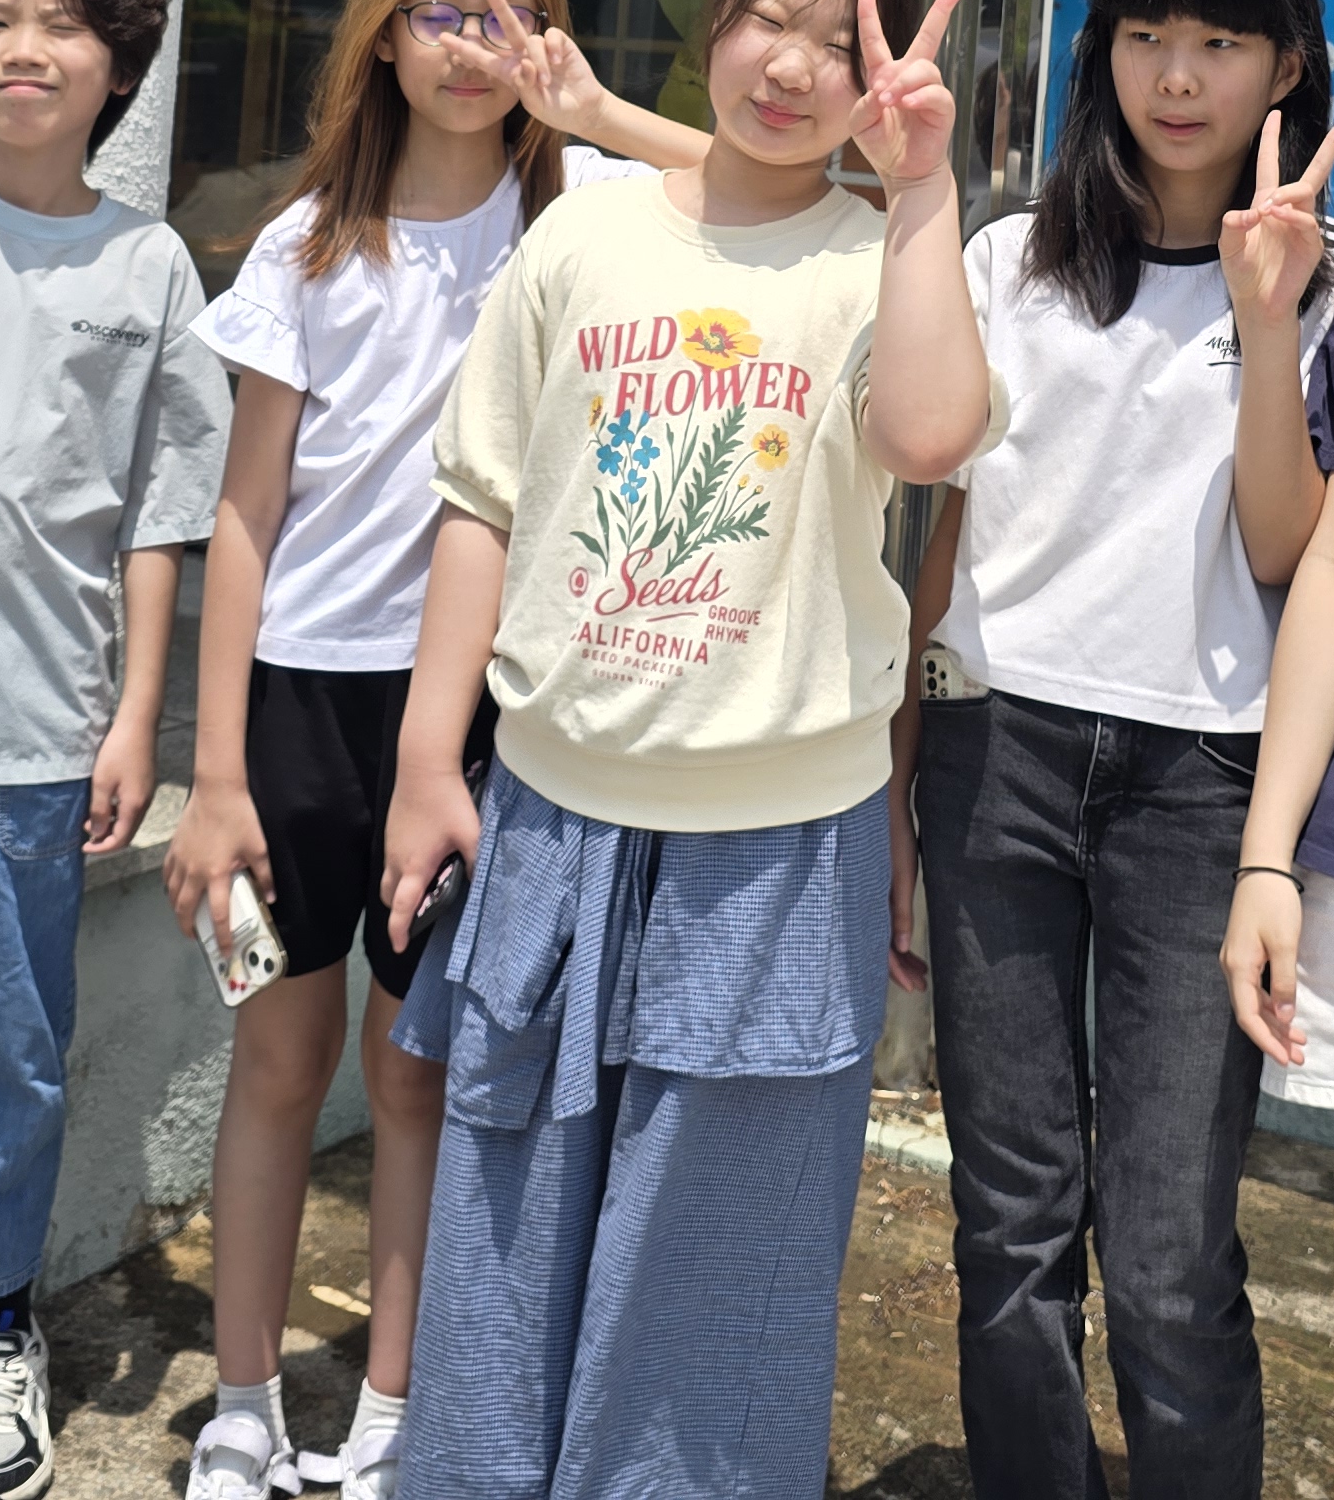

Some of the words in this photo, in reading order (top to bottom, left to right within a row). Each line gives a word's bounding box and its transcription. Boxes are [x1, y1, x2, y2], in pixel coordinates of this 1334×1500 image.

[578, 316, 678, 373] WILD
[613, 361, 812, 420] FLOWER
[594, 547, 731, 617] Seeds
[704, 623, 750, 644] RHYME
[708, 604, 762, 626] GROOVE
[570, 621, 709, 665] ALIFORNIA
[581, 648, 618, 664] SEED
[623, 655, 685, 677] PACKETS
